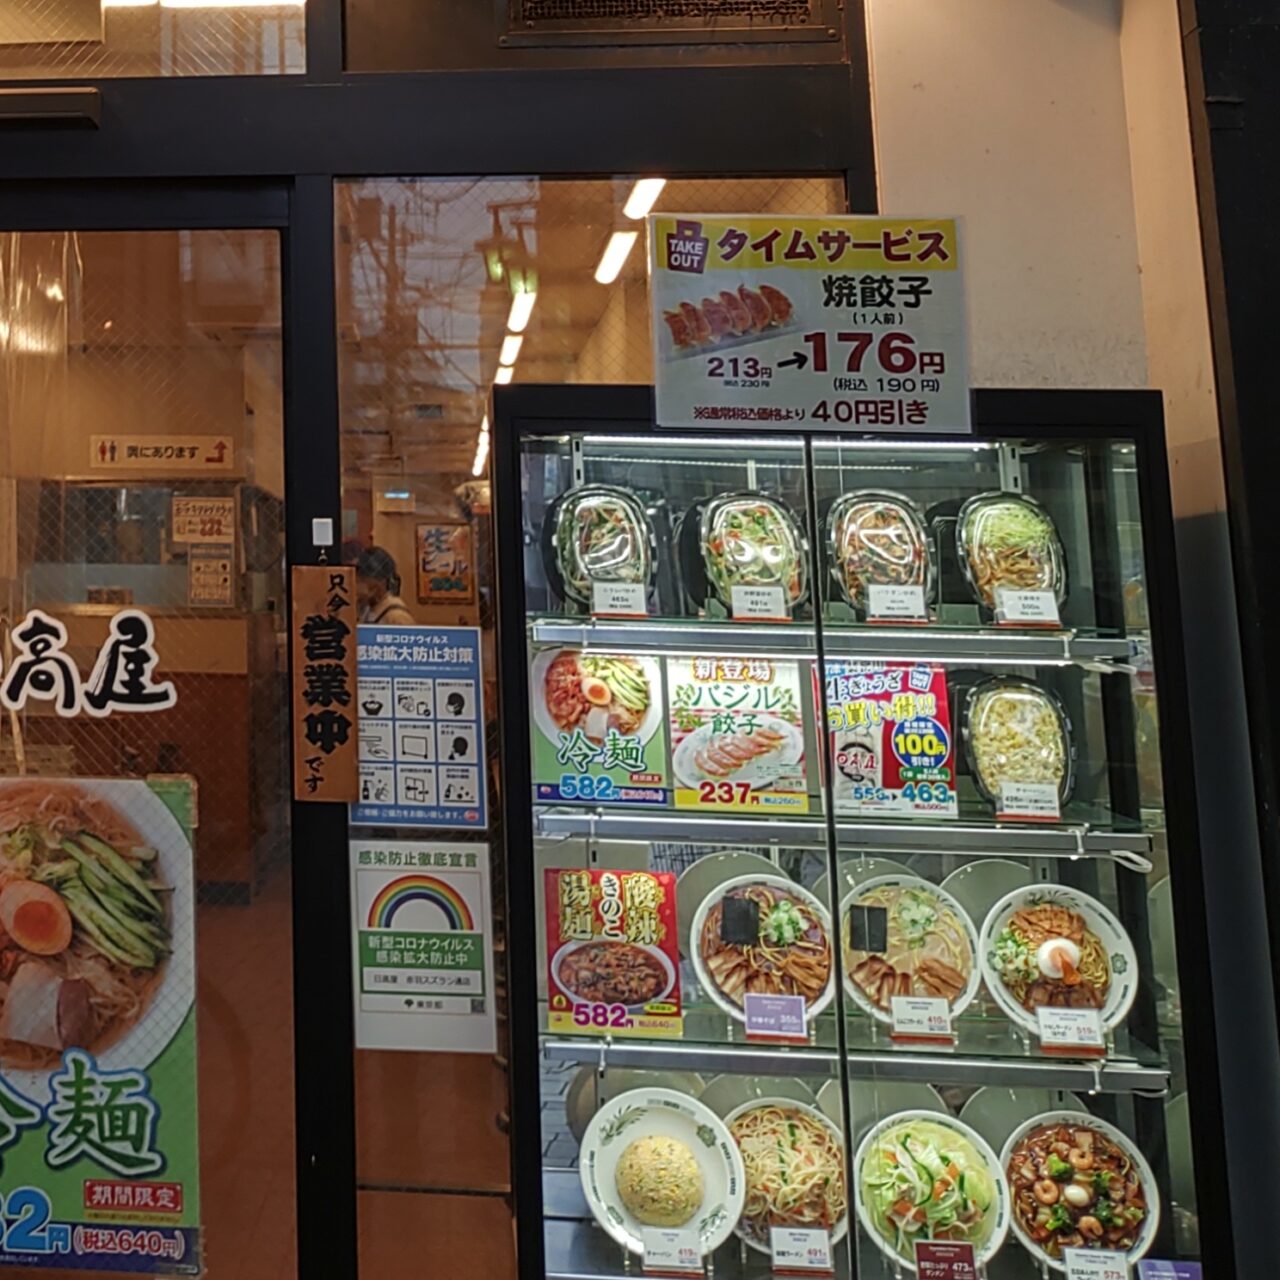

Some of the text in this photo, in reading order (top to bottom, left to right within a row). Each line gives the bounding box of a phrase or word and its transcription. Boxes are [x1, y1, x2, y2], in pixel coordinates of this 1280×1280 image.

[670, 239, 703, 253] TAKE
[718, 228, 950, 263] タイムサービス
[670, 255, 701, 269] OUT
[822, 275, 933, 309] 焼餃子
[804, 331, 945, 374] 176円
[707, 357, 772, 379] 213円
[691, 685, 782, 711] バジル
[710, 713, 763, 737] 餃子
[558, 730, 646, 772] 冷麺
[895, 733, 946, 756] 100円
[559, 775, 620, 799] 582円
[699, 781, 760, 805] 237円
[901, 783, 955, 804] 463円
[358, 851, 478, 868] 感染防止徹底宣言
[601, 874, 621, 938] きのこ
[368, 935, 475, 951] 新型コロナウイルス
[376, 950, 468, 966] 感染拡大防止中
[573, 1003, 634, 1029] 582円
[91, 1183, 175, 1208] 期間限定
[73, 1226, 186, 1260] (税込640円)
